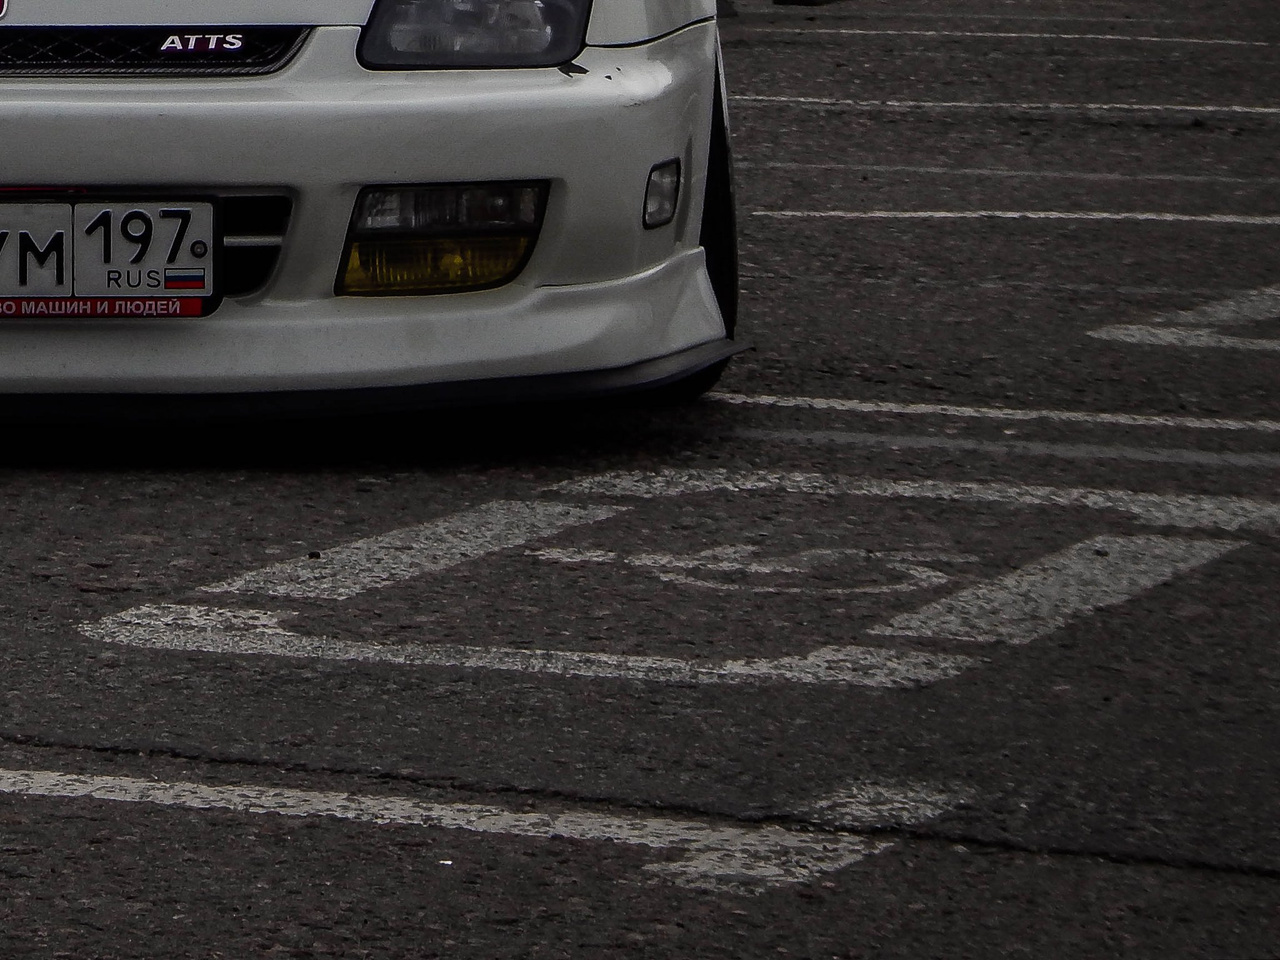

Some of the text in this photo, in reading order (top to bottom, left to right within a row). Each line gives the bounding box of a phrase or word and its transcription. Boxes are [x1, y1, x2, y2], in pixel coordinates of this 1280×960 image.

[160, 33, 243, 51] ATTS
[84, 209, 193, 265] 197
[106, 270, 161, 289] RUS
[21, 300, 93, 315] МАШИН
[96, 300, 110, 315] И
[114, 297, 181, 317] ЛЮДЕЙ
